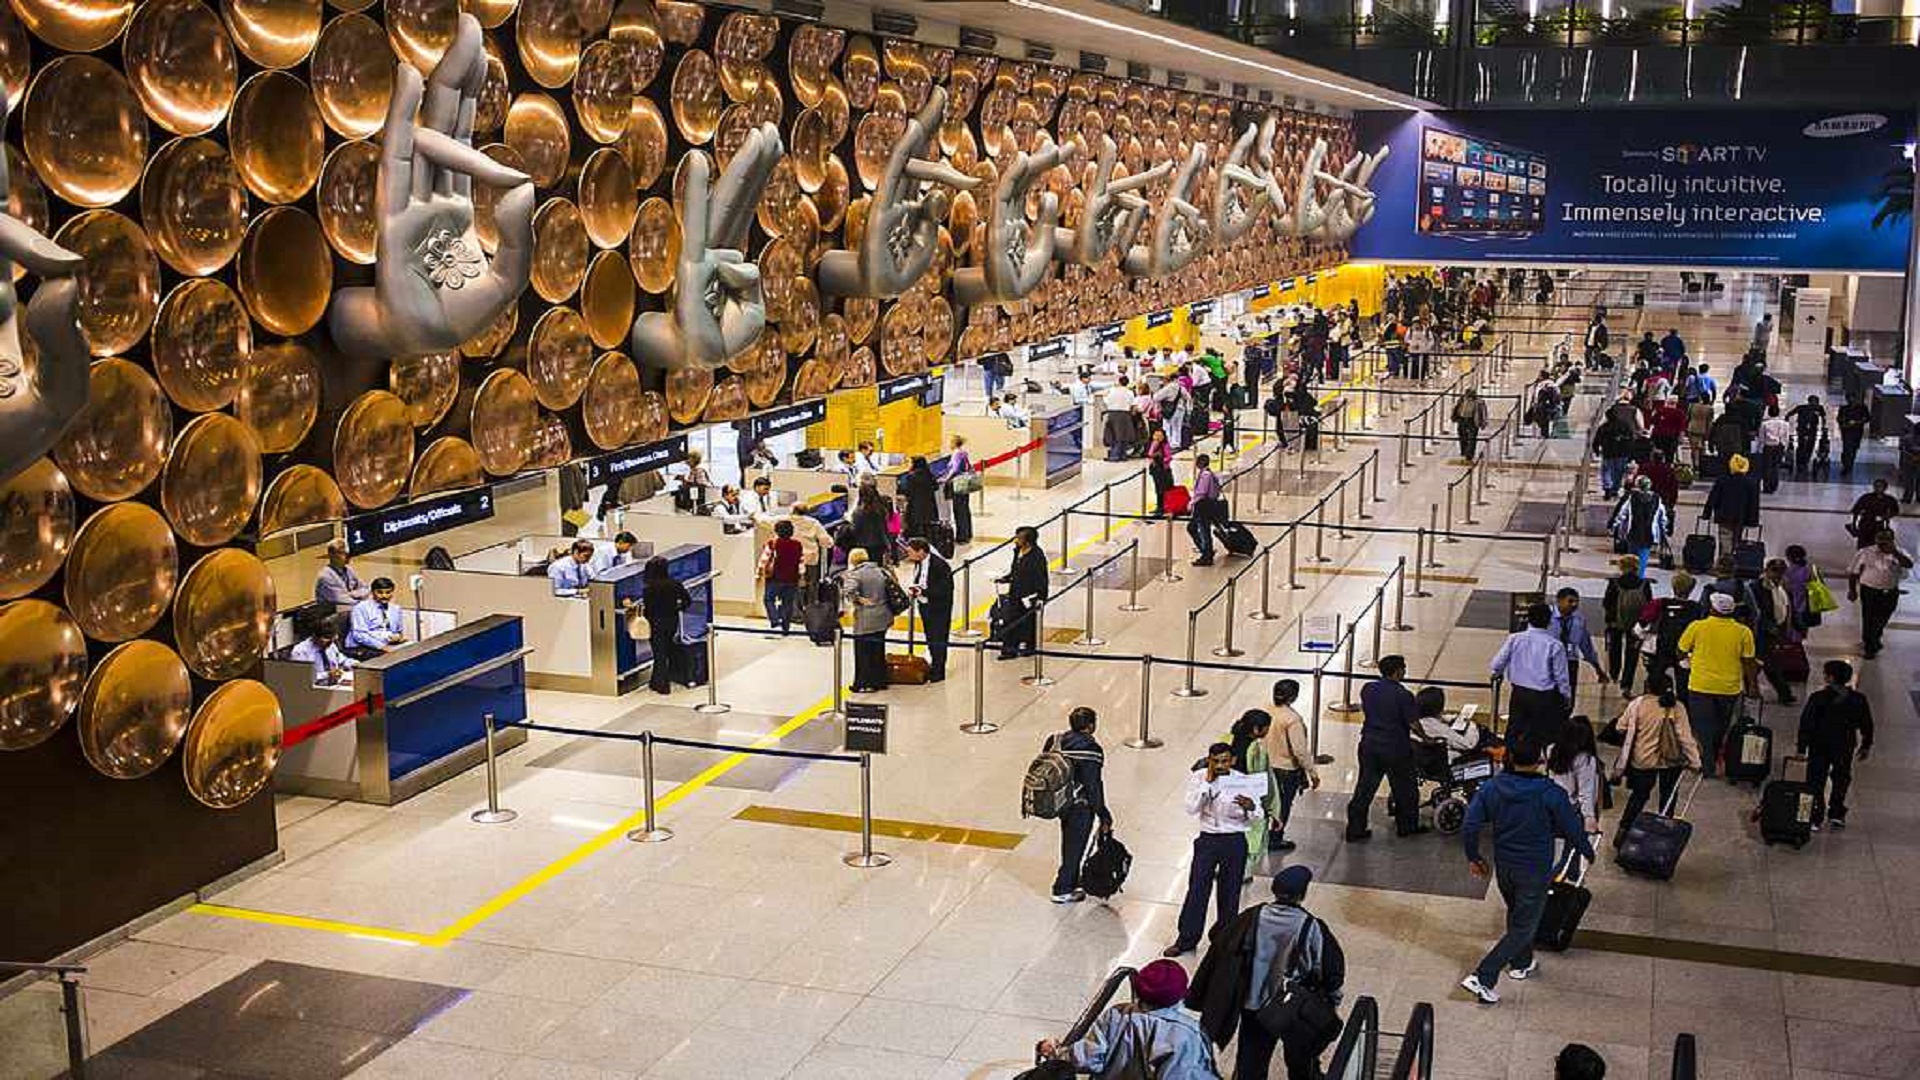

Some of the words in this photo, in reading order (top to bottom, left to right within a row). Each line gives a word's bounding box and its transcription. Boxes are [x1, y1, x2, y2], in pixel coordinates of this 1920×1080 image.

[1813, 119, 1876, 131] SAMSUNG
[1745, 146, 1767, 162] TV
[1602, 175, 1677, 198] Totally
[1684, 175, 1786, 193] intuitive.
[1561, 203, 1685, 227] Immensely
[1692, 203, 1826, 222] interactive.
[592, 465, 599, 478] 3
[353, 530, 364, 543] 1
[480, 496, 489, 509] 2
